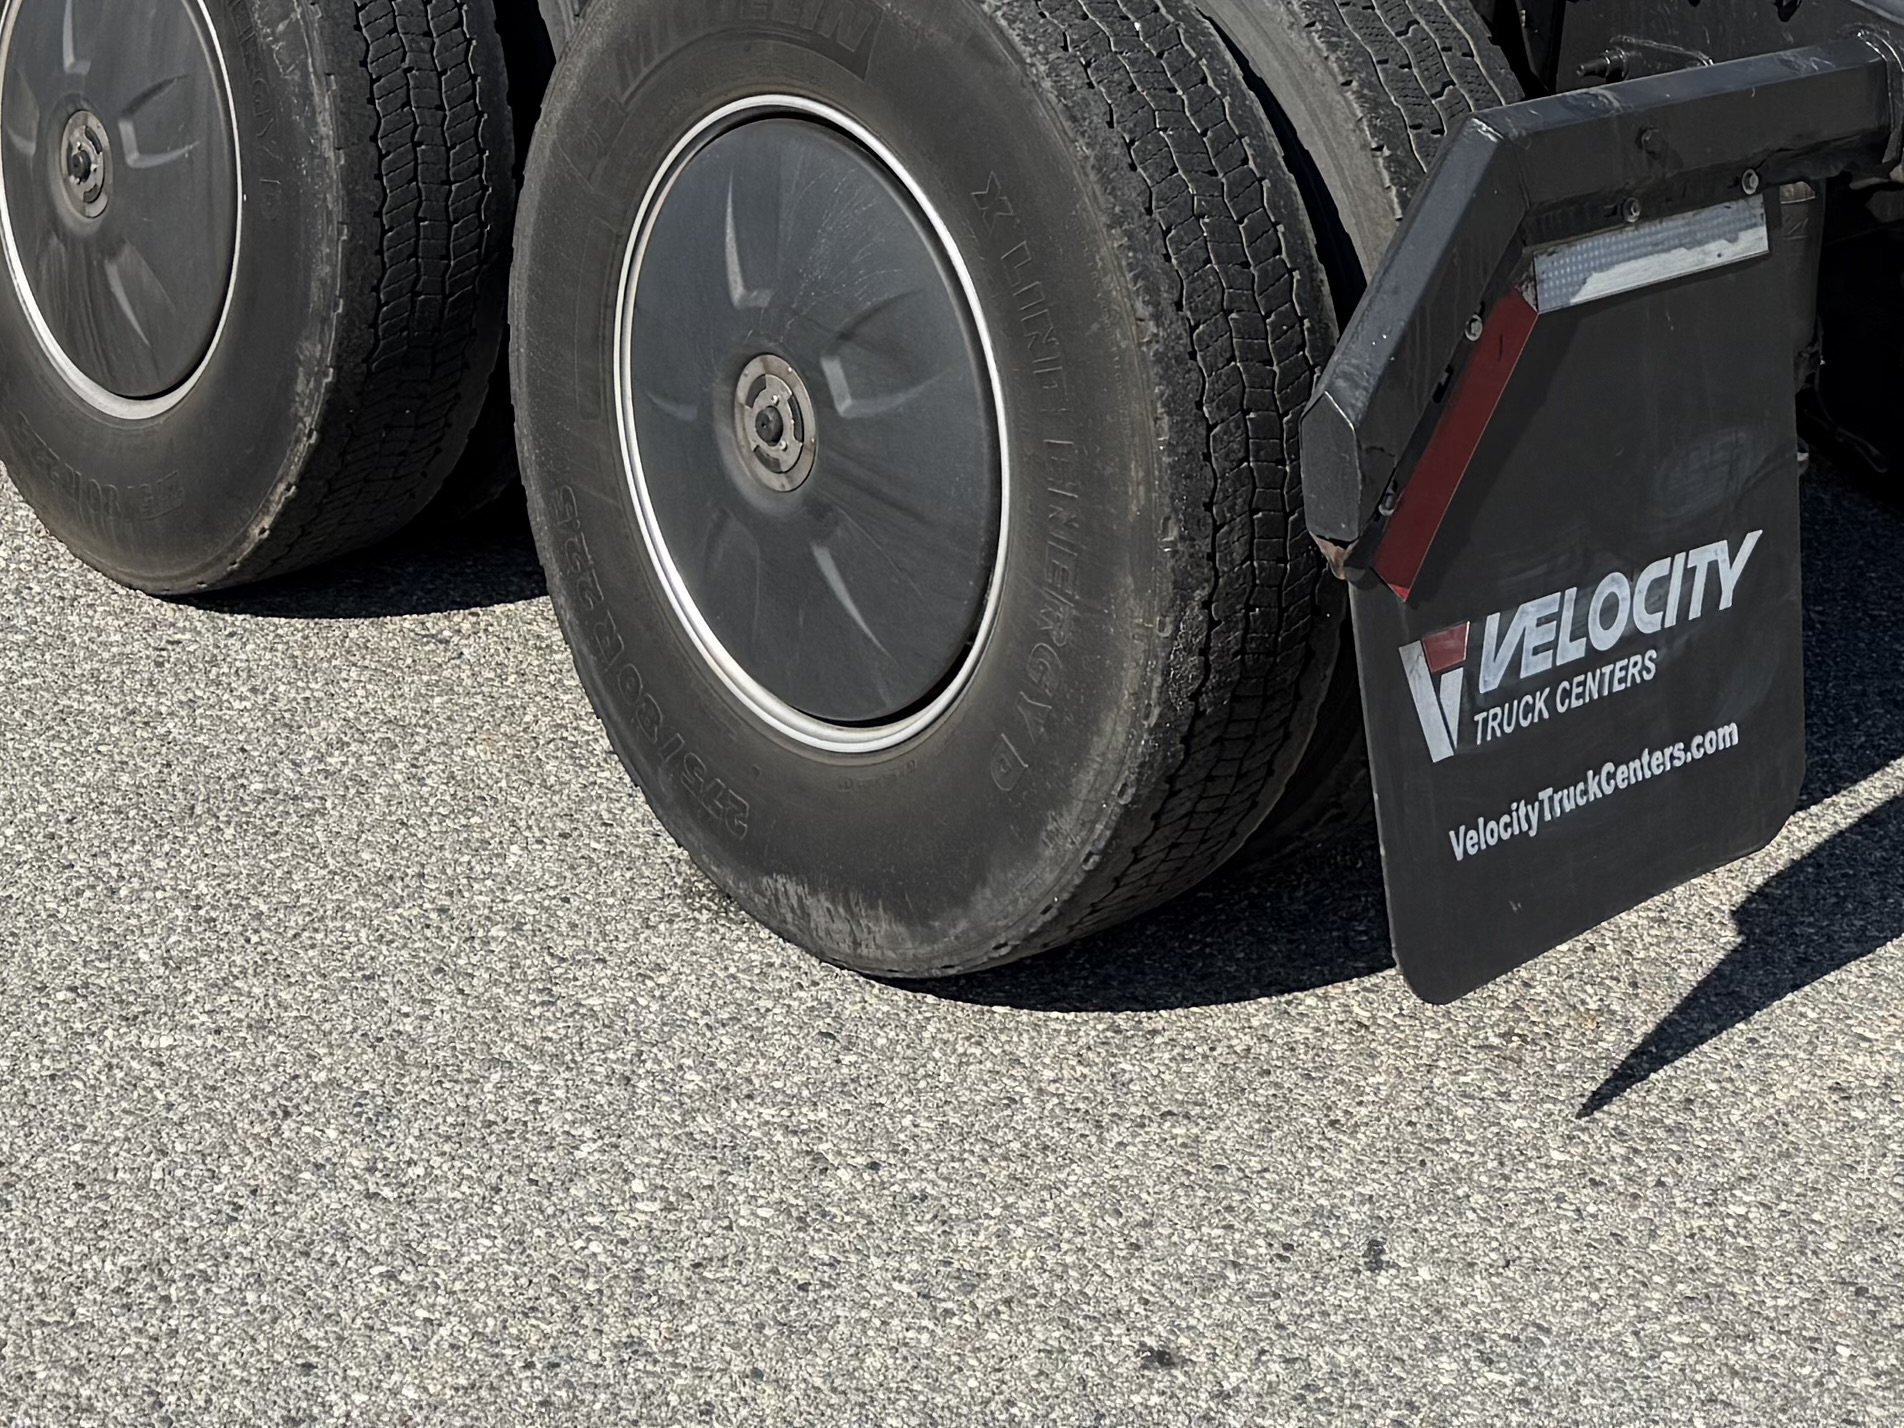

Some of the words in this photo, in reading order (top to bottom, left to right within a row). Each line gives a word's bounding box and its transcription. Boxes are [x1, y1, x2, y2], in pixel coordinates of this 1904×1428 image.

[1479, 530, 1763, 694] VELOCITY
[1474, 686, 1549, 745] TRUCK
[1555, 649, 1657, 714] CENTERS
[1449, 721, 1739, 862] VelocityTruckCenters.com
